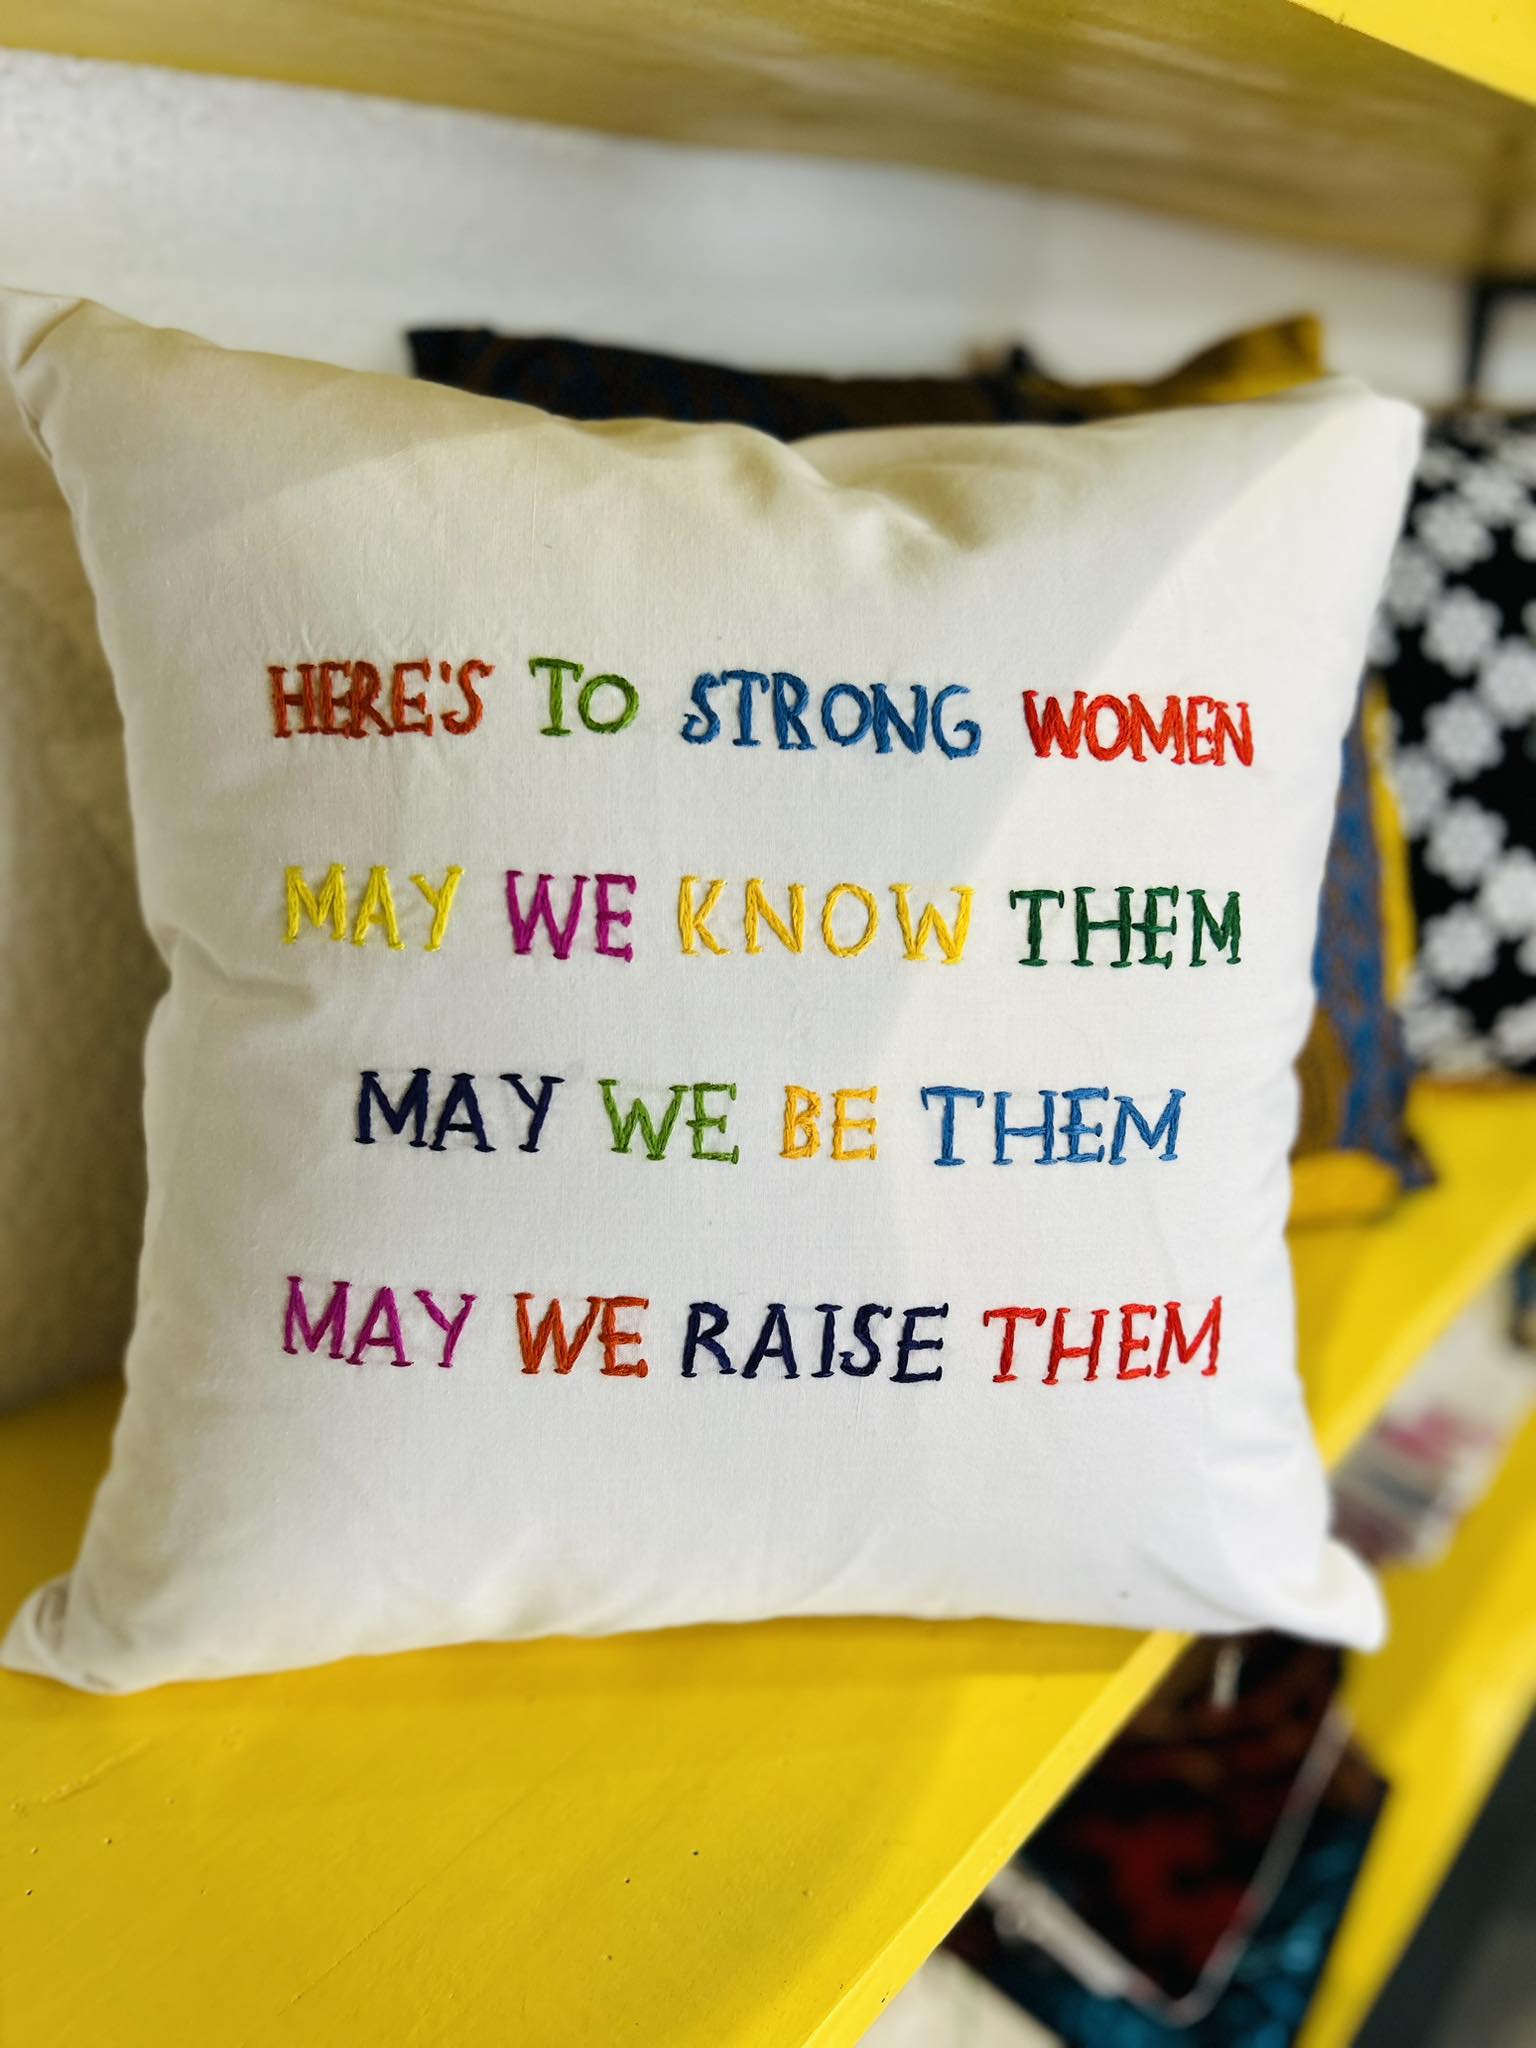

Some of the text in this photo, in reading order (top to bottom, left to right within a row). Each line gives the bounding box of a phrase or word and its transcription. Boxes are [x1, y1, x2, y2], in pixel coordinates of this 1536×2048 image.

[267, 656, 1255, 767] HERE'S TO STRONG WOMEN
[281, 864, 1242, 970] MAY WE KNOW THEM
[354, 1067, 1187, 1166] MAY WE BE THEM
[282, 1275, 1223, 1386] MAY WE RAISE THEM
